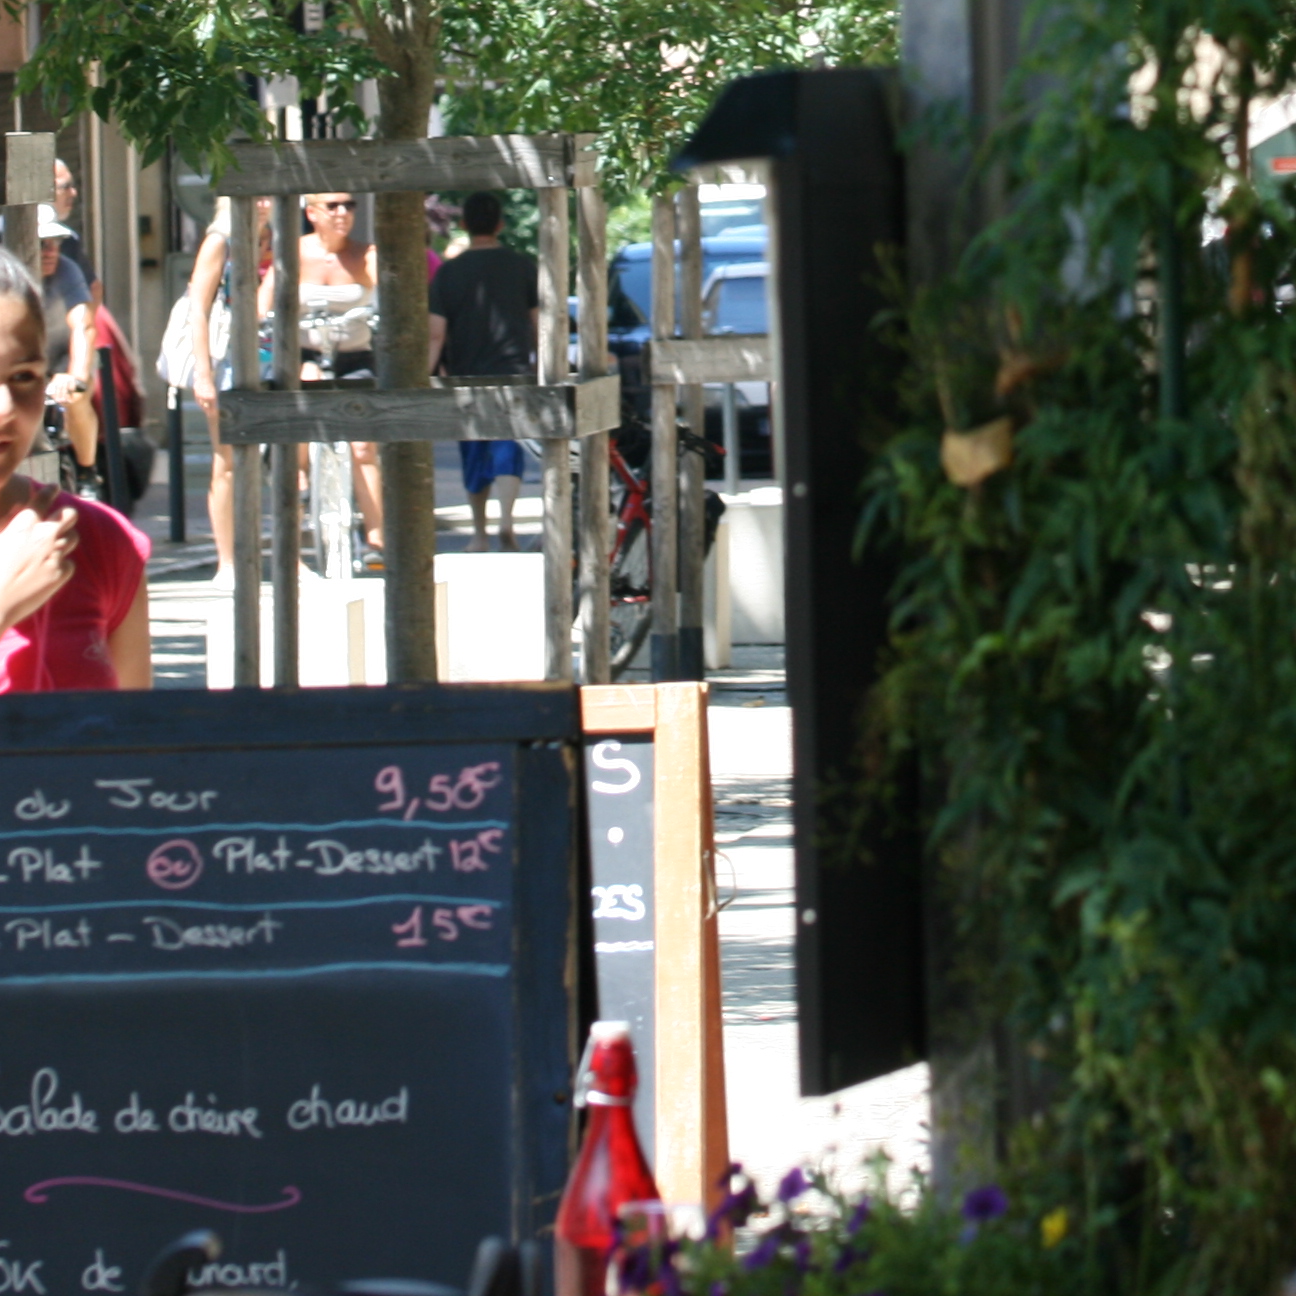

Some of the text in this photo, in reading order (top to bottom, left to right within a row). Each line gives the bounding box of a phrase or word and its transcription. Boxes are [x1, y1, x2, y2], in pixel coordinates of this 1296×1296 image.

[14, 788, 71, 820] du
[94, 777, 218, 811] Jour
[114, 1091, 160, 1133] de
[287, 1083, 409, 1131] chaud
[81, 1247, 125, 1292] de
